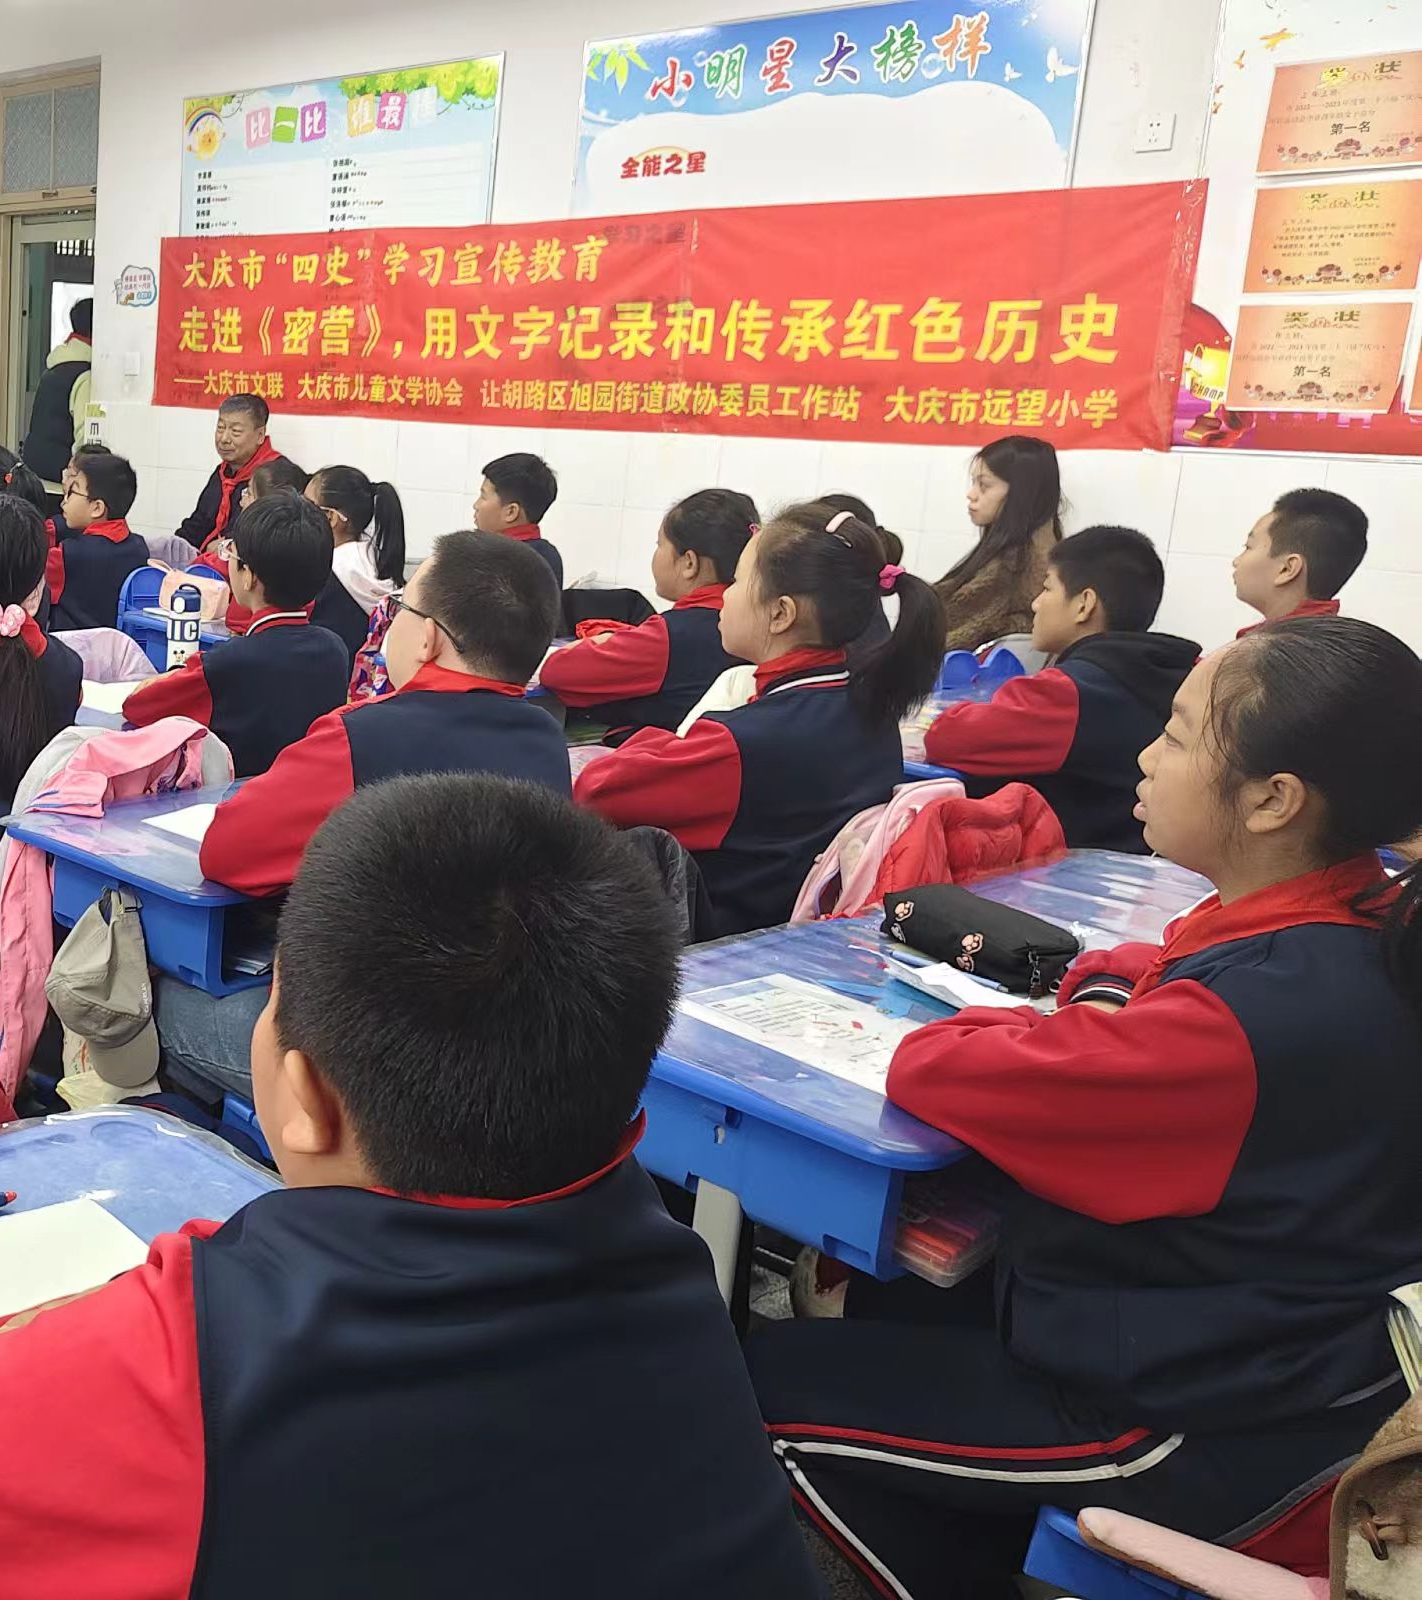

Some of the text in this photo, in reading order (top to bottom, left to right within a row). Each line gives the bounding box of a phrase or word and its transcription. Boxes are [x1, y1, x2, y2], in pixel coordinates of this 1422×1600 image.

[649, 11, 991, 100] 小明星大榜样
[247, 104, 326, 143] 比一比
[1330, 121, 1371, 136] 第一名
[620, 150, 707, 180] 全能之星
[181, 234, 609, 291] 大庆市“四史”学习宣传教育
[178, 293, 1119, 365] 走进《密营》，用文字记录和传承红色历史
[1293, 365, 1332, 378] 第一名
[297, 372, 464, 407] 大庆市儿童文学协会
[481, 378, 860, 422] 让胡路区旭园街道政协委员工作站
[884, 386, 1119, 430] 大庆市远望小学
